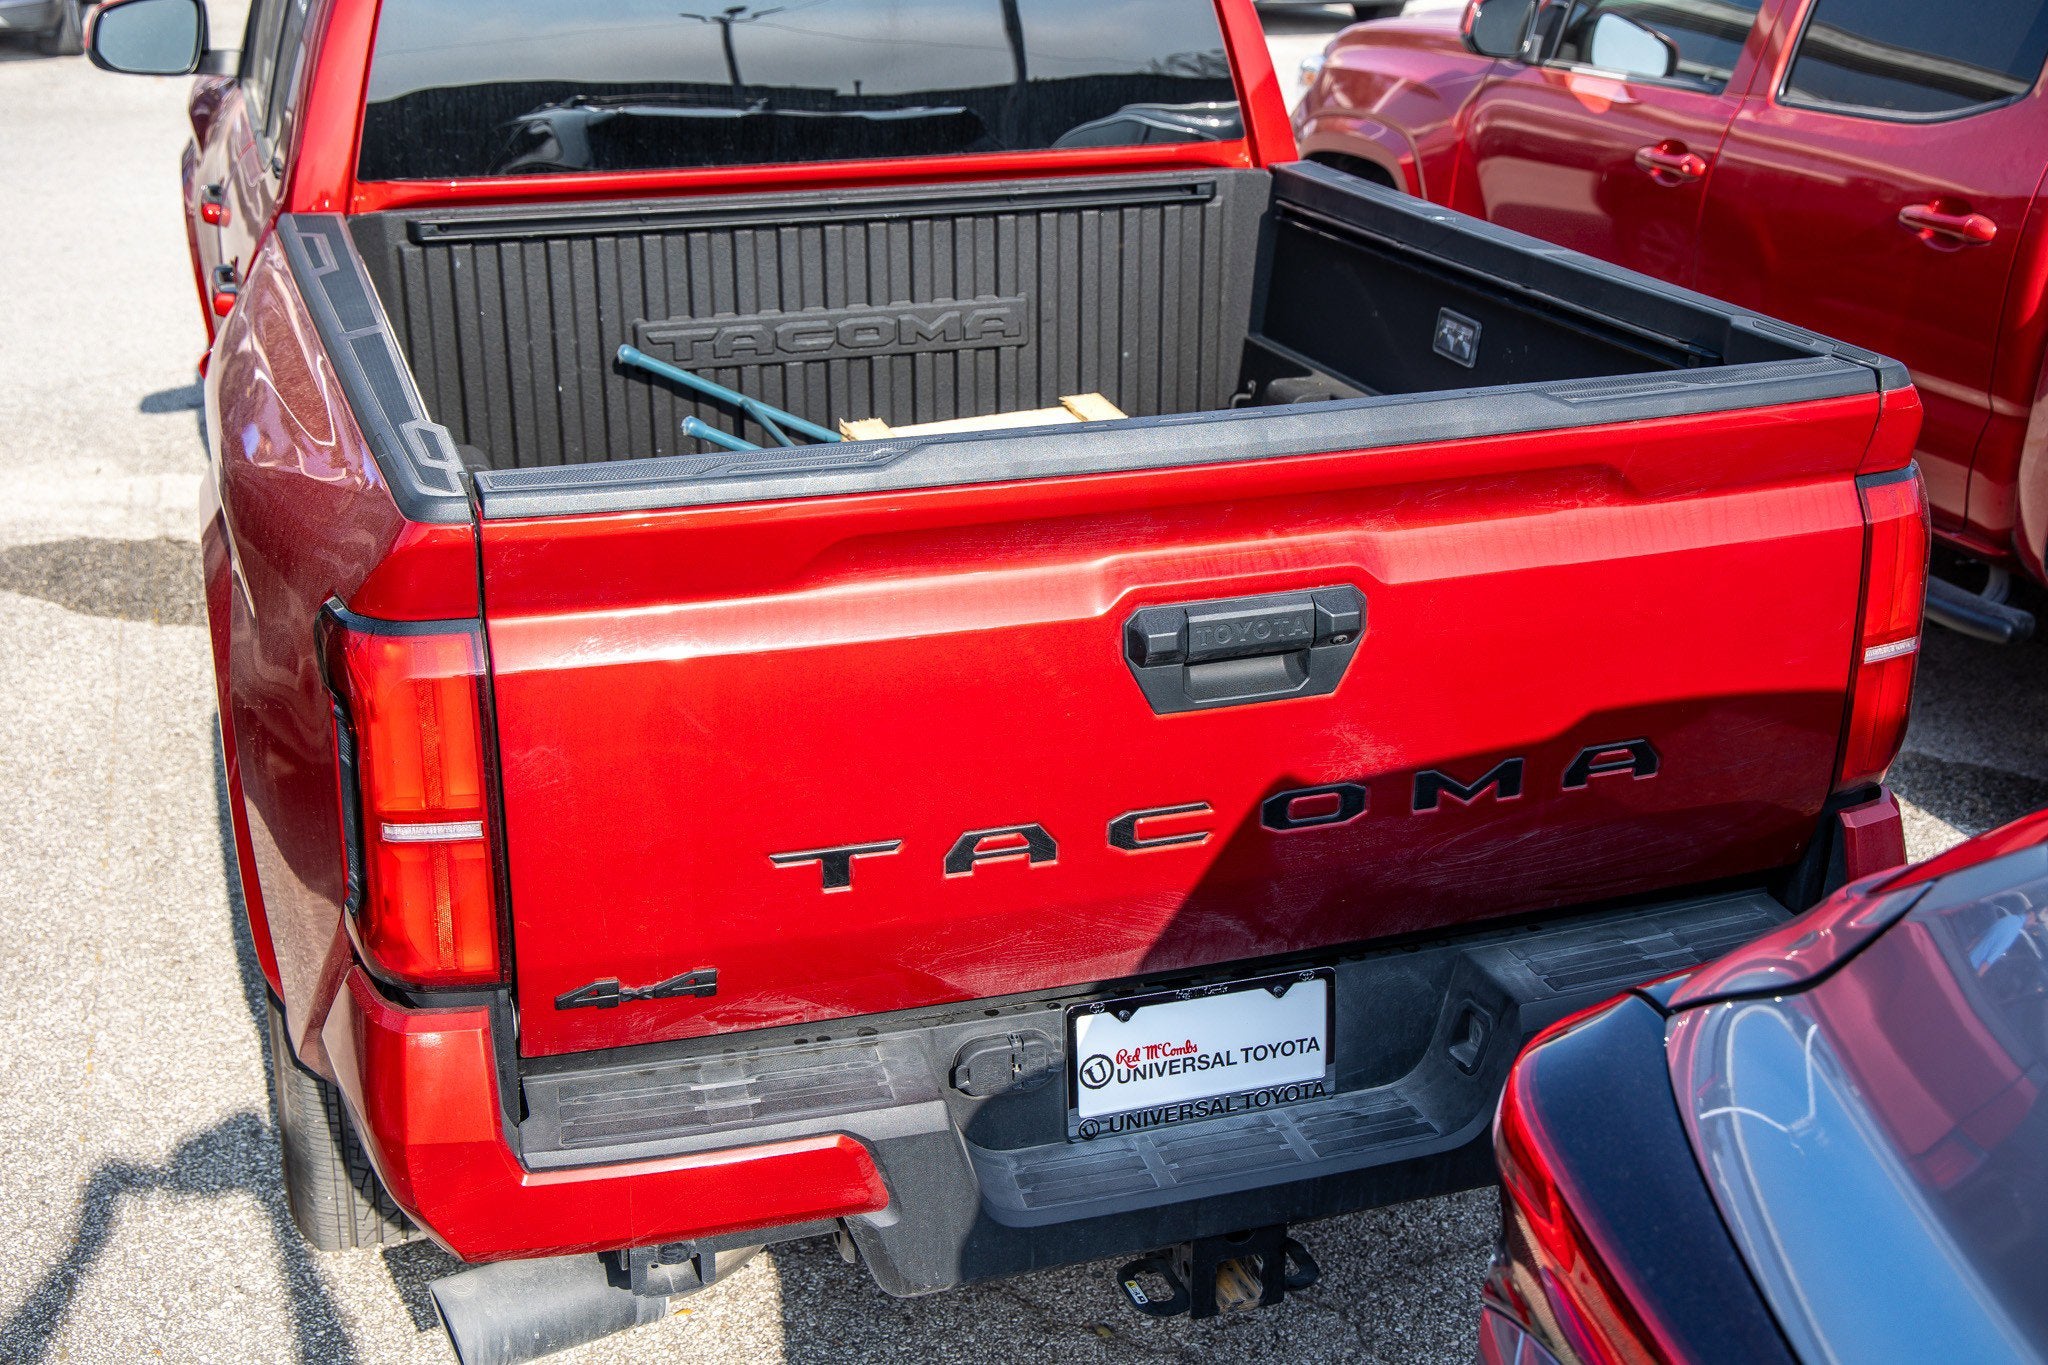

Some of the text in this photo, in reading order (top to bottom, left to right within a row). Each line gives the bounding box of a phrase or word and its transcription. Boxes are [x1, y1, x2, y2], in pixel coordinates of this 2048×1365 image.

[646, 307, 1021, 361] TACOMA
[1196, 616, 1309, 646] TOYOTA
[769, 738, 1660, 893] TACOMA
[1115, 1039, 1198, 1069] Red McCombs
[1117, 1036, 1321, 1085] UNIVERSAL TOYOTA
[1109, 1080, 1327, 1133] UNIVERSAL TOYOTA
